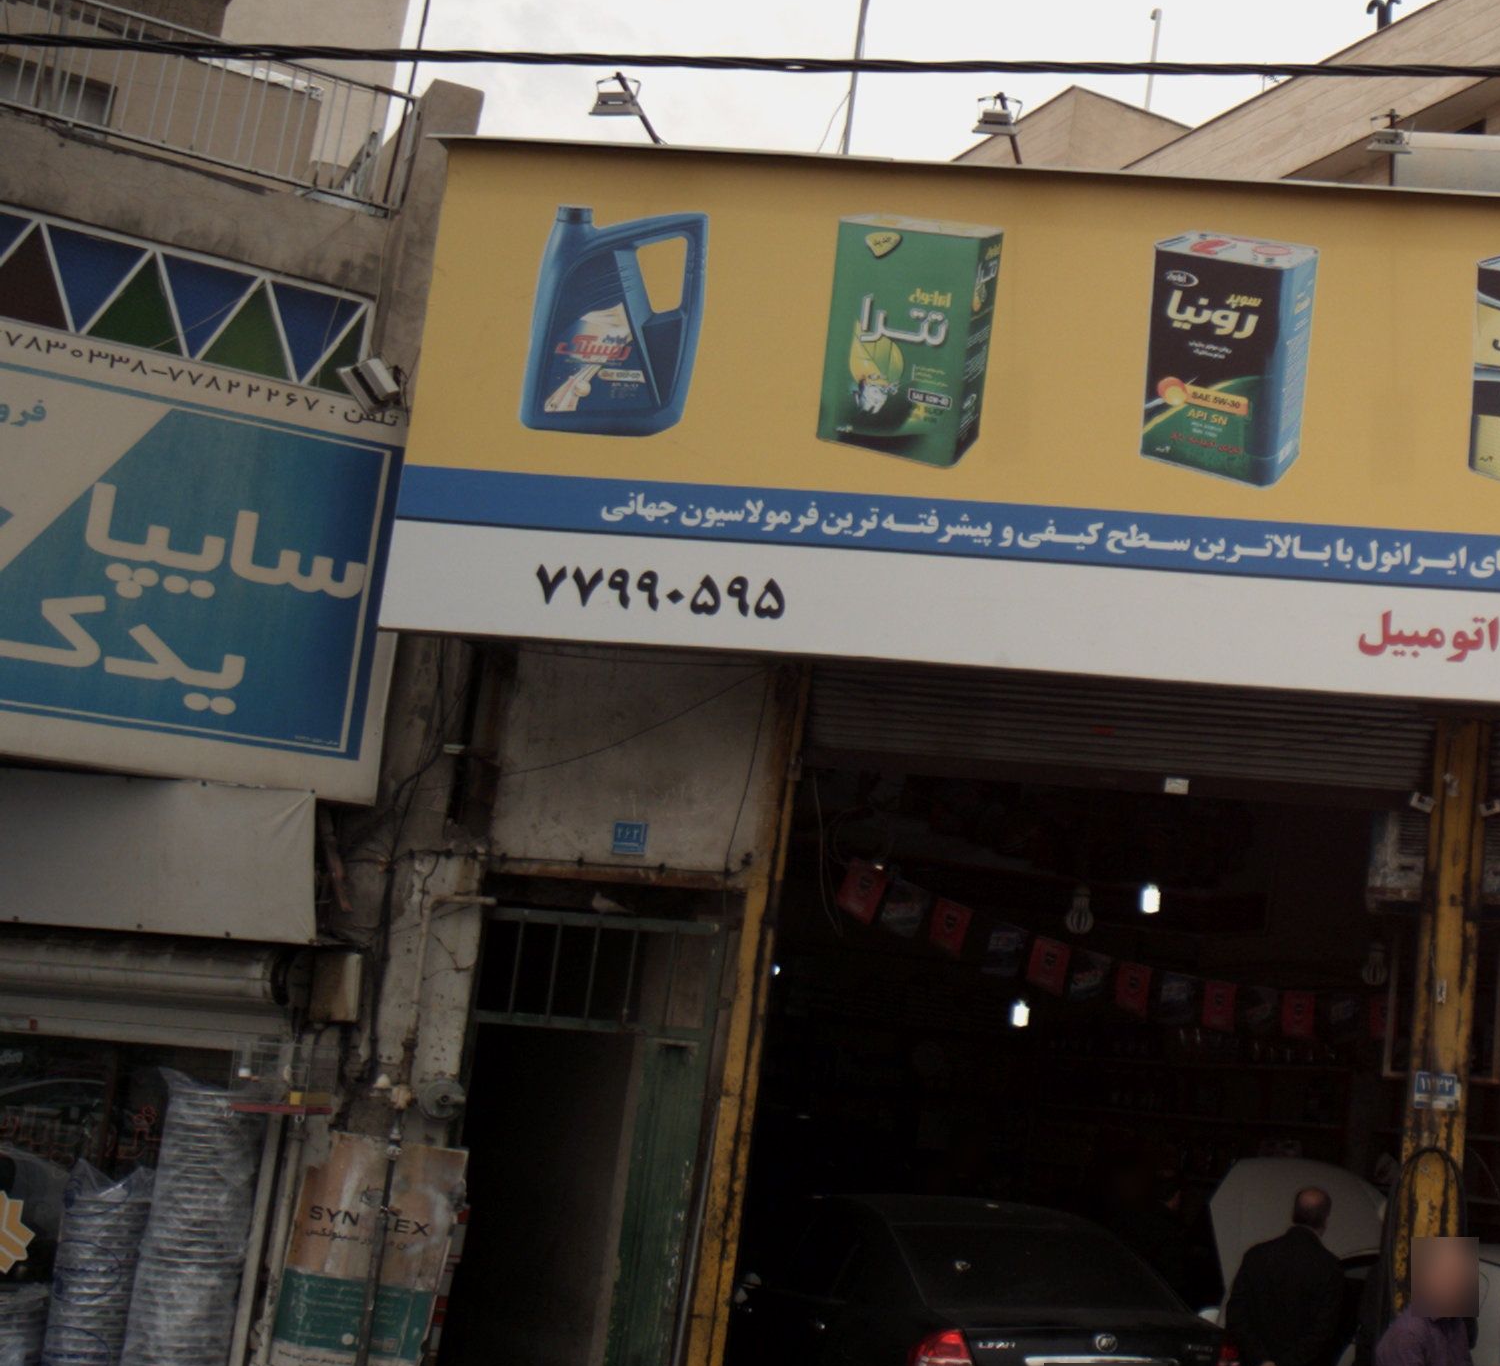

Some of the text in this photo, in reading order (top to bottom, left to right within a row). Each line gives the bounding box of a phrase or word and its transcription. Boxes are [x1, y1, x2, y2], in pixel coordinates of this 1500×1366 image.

[1166, 289, 1260, 340] رونیا
[1225, 293, 1263, 309] سوپر
[859, 291, 950, 347] تترا
[1186, 408, 1229, 426] API SN
[1192, 391, 1241, 409] SAE 5W-30
[601, 491, 678, 525] جهانی
[679, 499, 820, 534] فرمولاسیون
[85, 482, 366, 599] سایپا
[998, 524, 1014, 548] و
[1016, 518, 1105, 551] کیفی
[1105, 523, 1191, 554] سطح
[1193, 532, 1333, 568] بالاترین
[1335, 537, 1355, 571] با
[1356, 538, 1468, 576] ایرانول
[536, 563, 786, 620] ۷۷۹۹۰۵۹۵
[1357, 609, 1500, 663] اتومبیل
[0, 595, 246, 715] یدک
